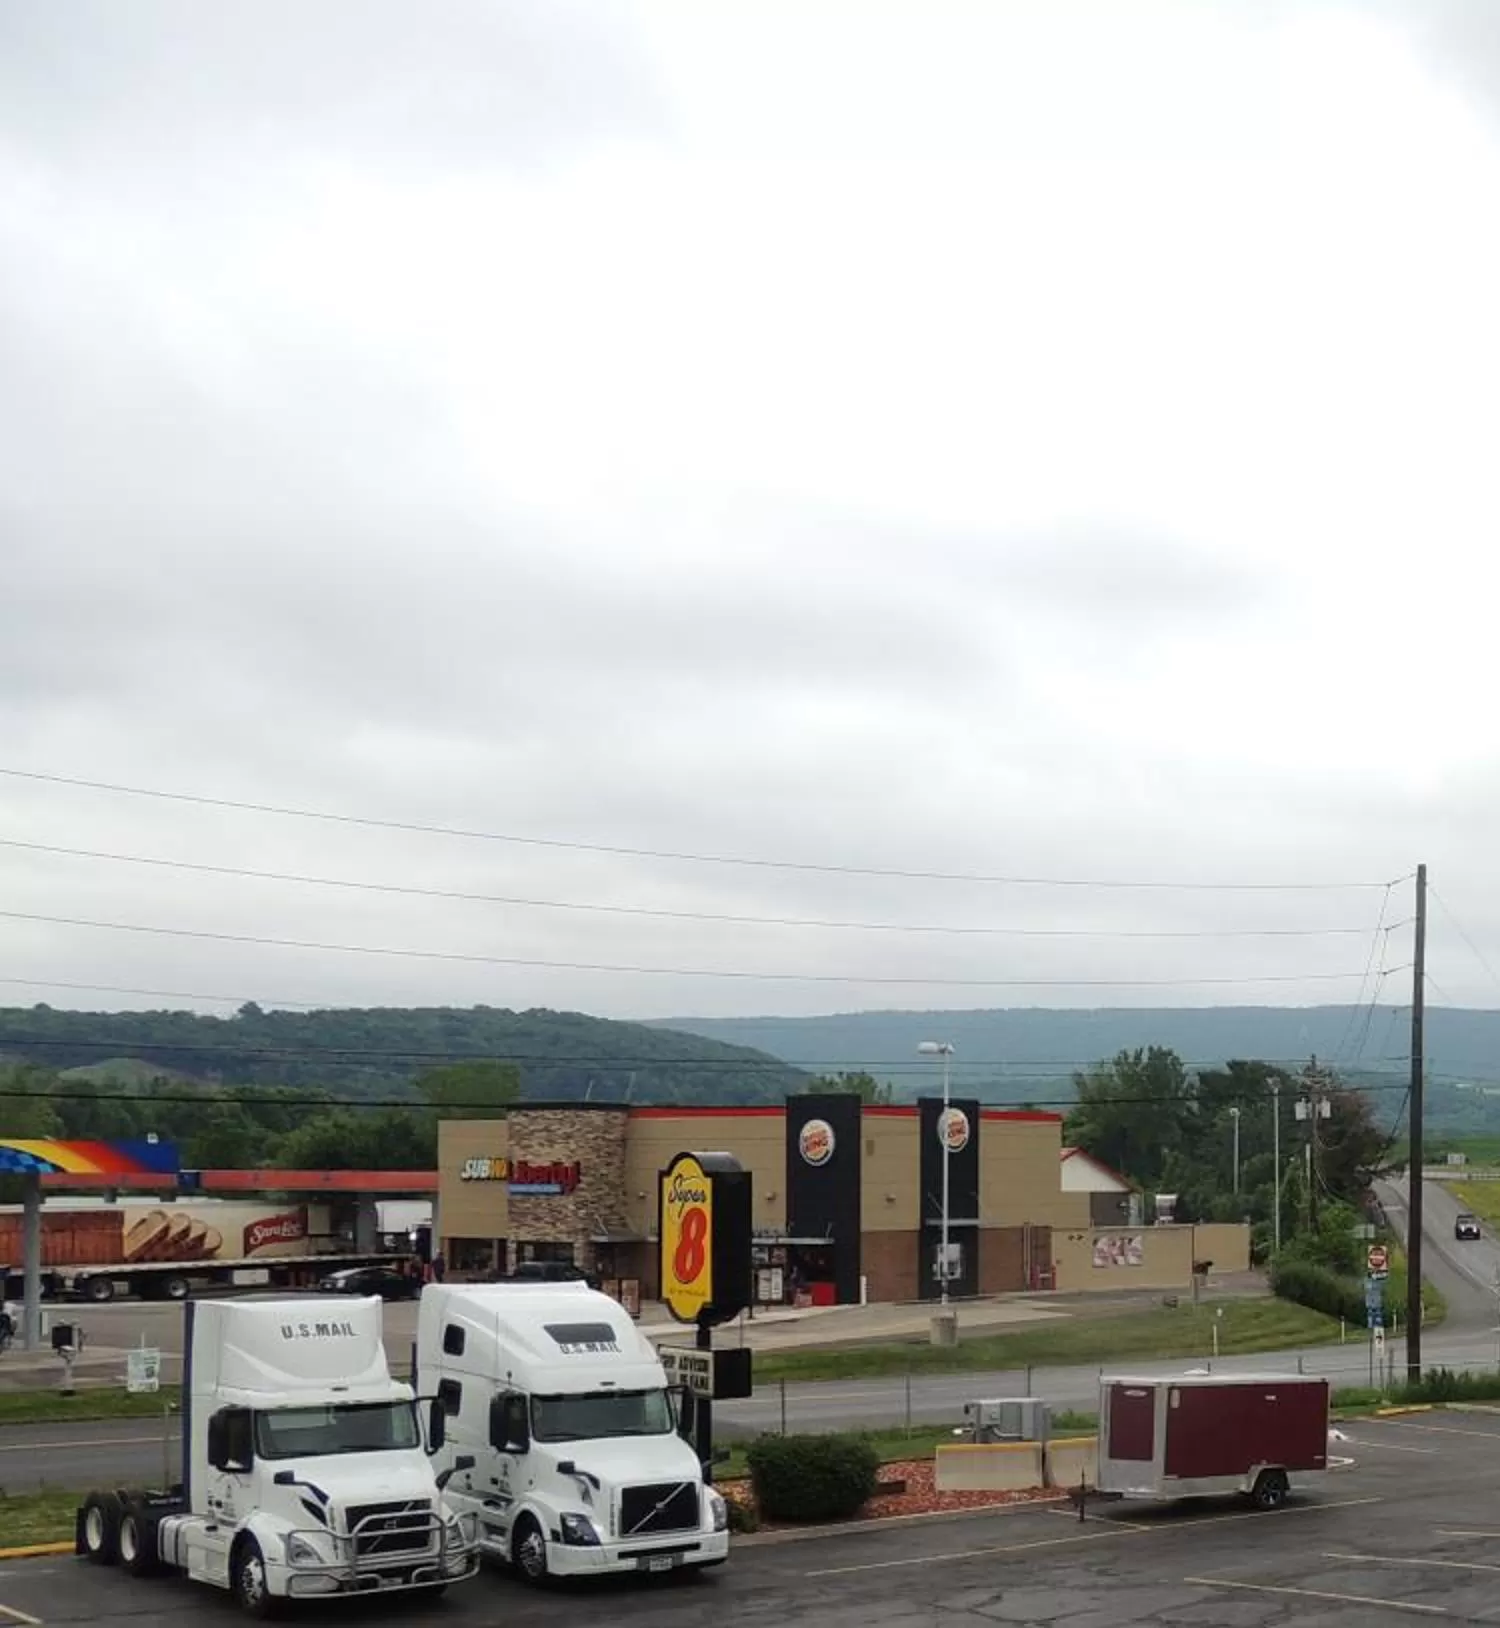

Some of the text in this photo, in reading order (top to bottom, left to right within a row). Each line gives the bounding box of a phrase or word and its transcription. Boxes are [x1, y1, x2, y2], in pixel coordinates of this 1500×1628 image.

[668, 1173, 706, 1218] Super
[249, 1225, 281, 1245] Sara
[673, 1207, 707, 1284] 8
